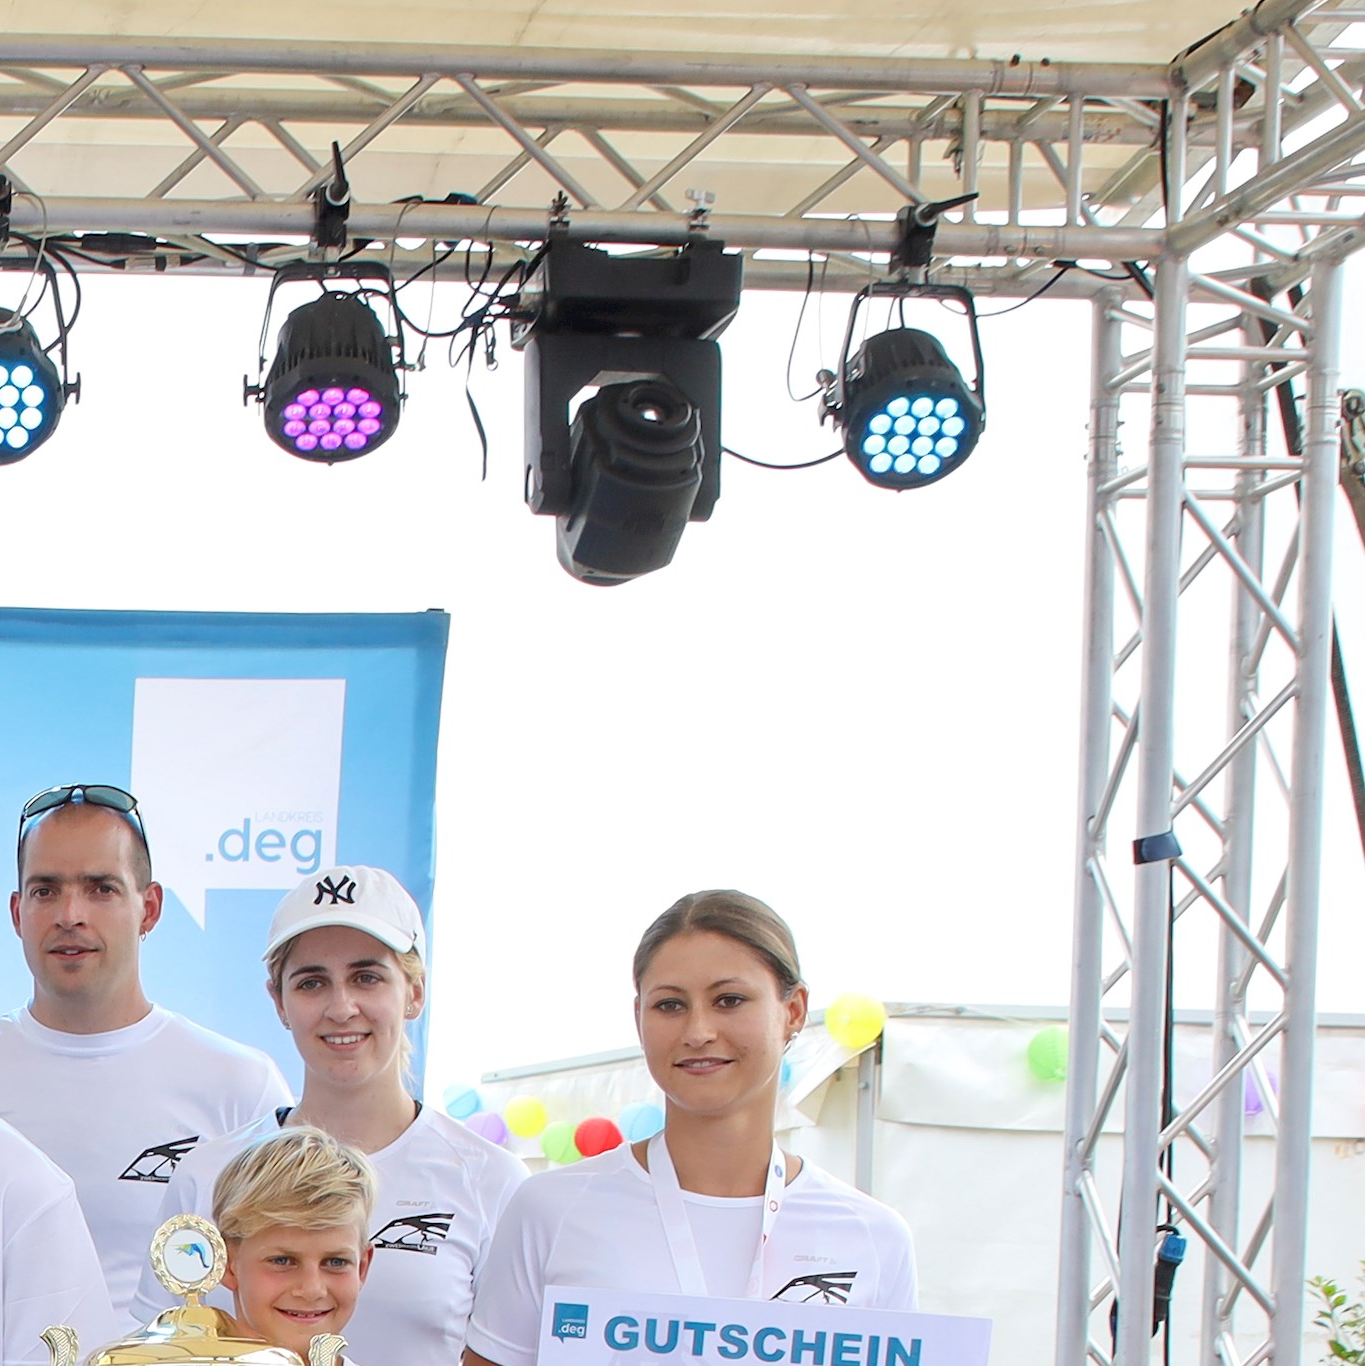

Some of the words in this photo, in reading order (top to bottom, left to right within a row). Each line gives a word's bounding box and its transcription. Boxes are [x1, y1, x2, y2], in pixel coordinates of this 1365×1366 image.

[254, 811, 324, 823] LANDKREIS
[205, 818, 323, 875] .deg
[314, 875, 357, 905] NY
[558, 1323, 585, 1337] .deg
